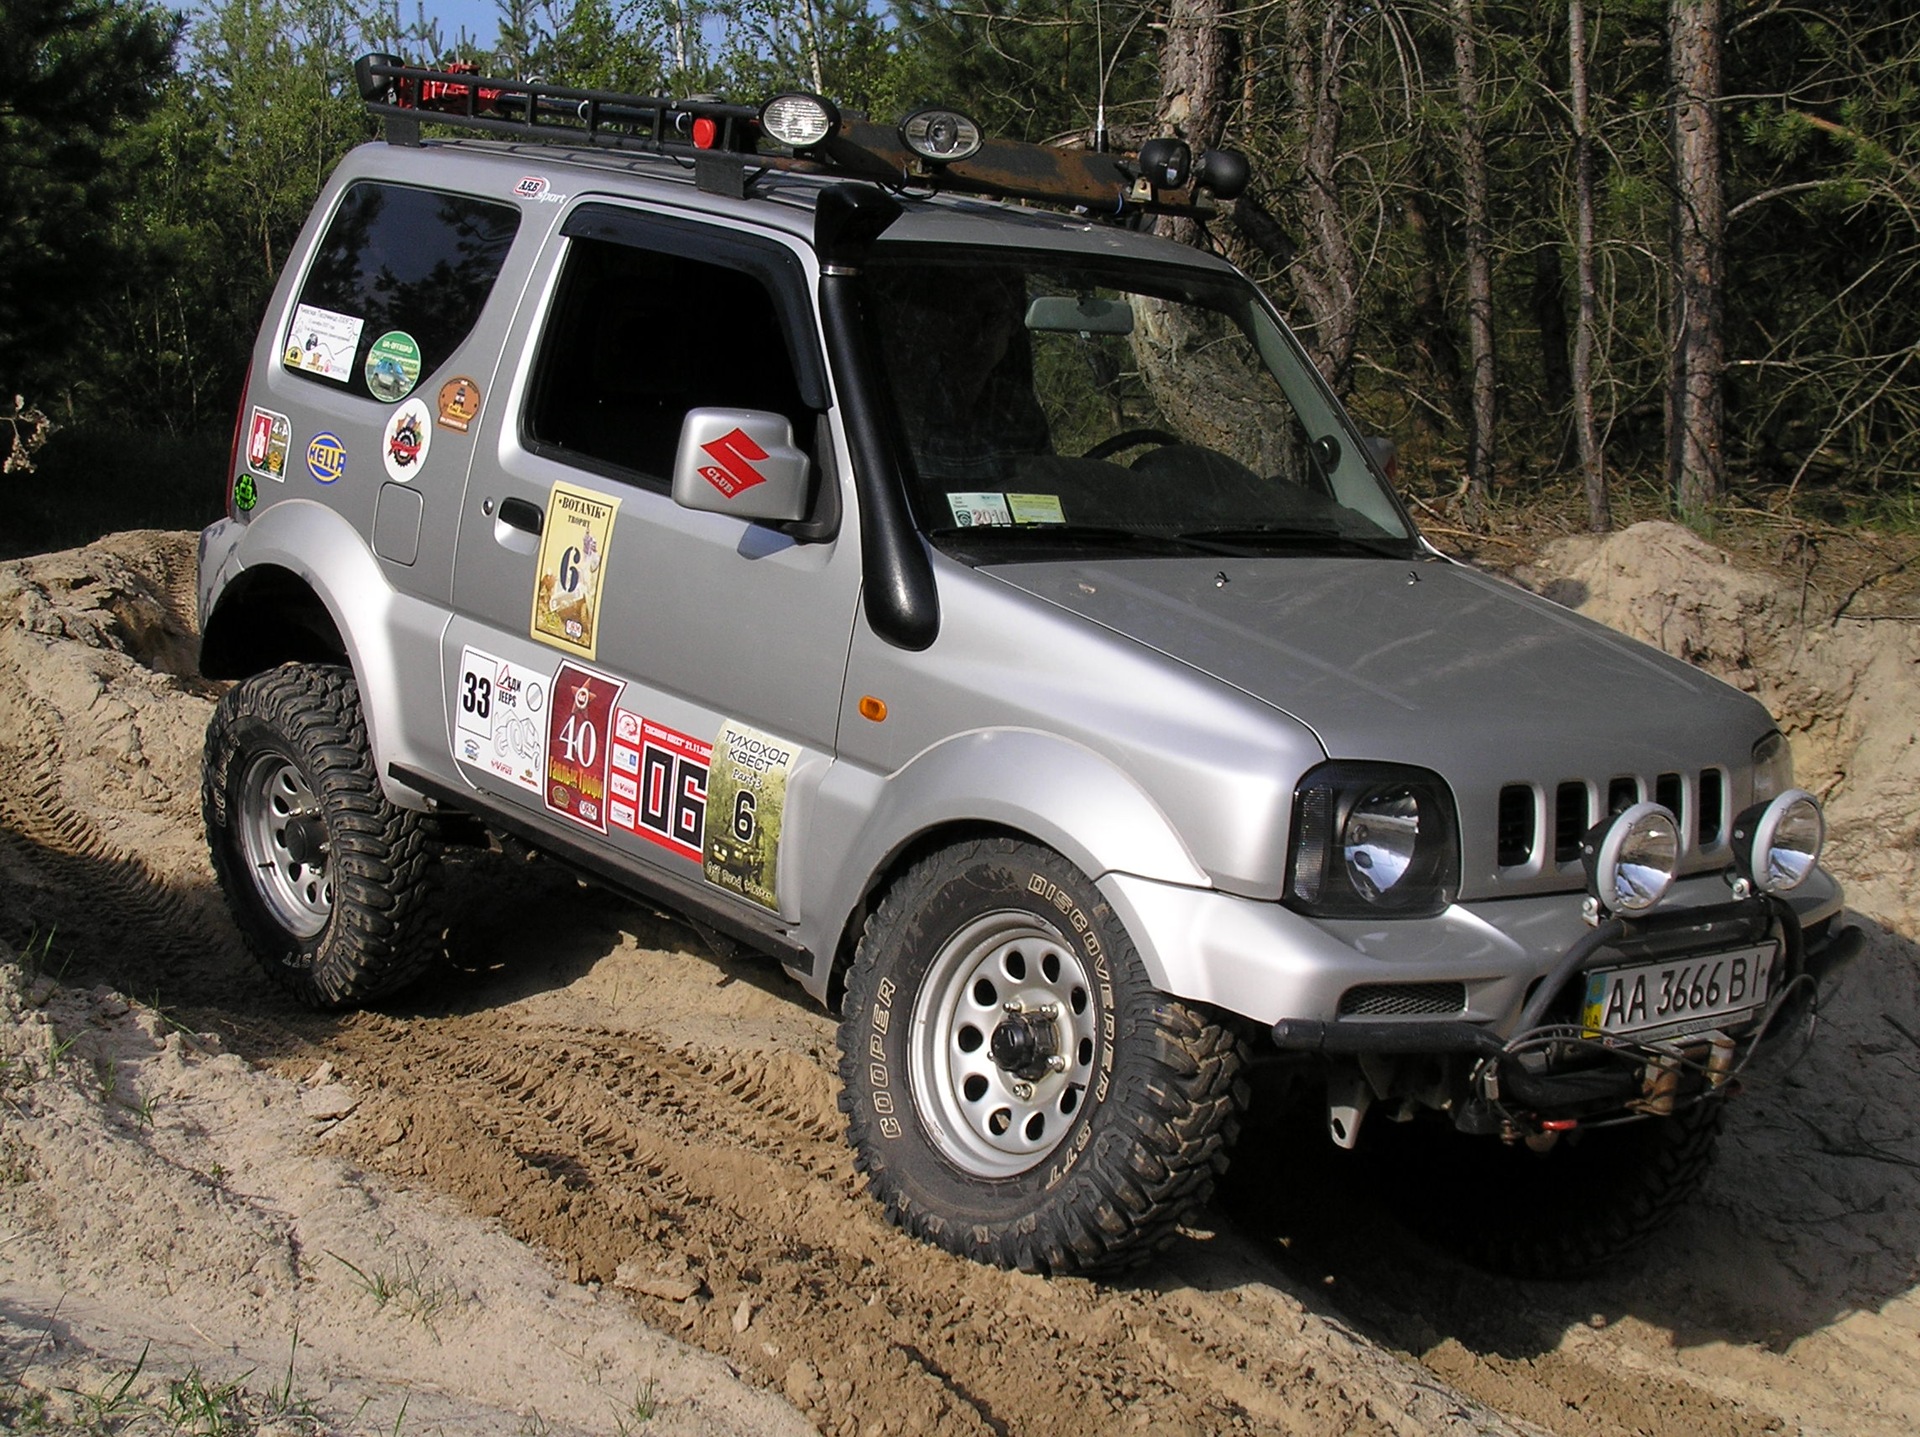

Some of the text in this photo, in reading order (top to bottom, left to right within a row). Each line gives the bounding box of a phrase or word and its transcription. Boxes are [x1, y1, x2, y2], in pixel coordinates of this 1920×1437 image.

[518, 180, 541, 192] ARB
[308, 445, 346, 477] HELLA
[706, 467, 734, 494] CLUB
[568, 515, 590, 530] TROPHY
[560, 546, 581, 593] 6
[463, 671, 491, 719] 33
[498, 690, 517, 708] JEEPS
[559, 715, 597, 768] 40
[725, 730, 790, 767] ТИХОХОД
[728, 748, 773, 774] КВЕСТ
[641, 745, 708, 849] 06
[734, 790, 757, 843] 6
[1027, 873, 1115, 1103] DISCOVERER
[1602, 974, 1647, 1027] AA
[1655, 961, 1724, 1016] 3666
[869, 976, 901, 1139] COOPER
